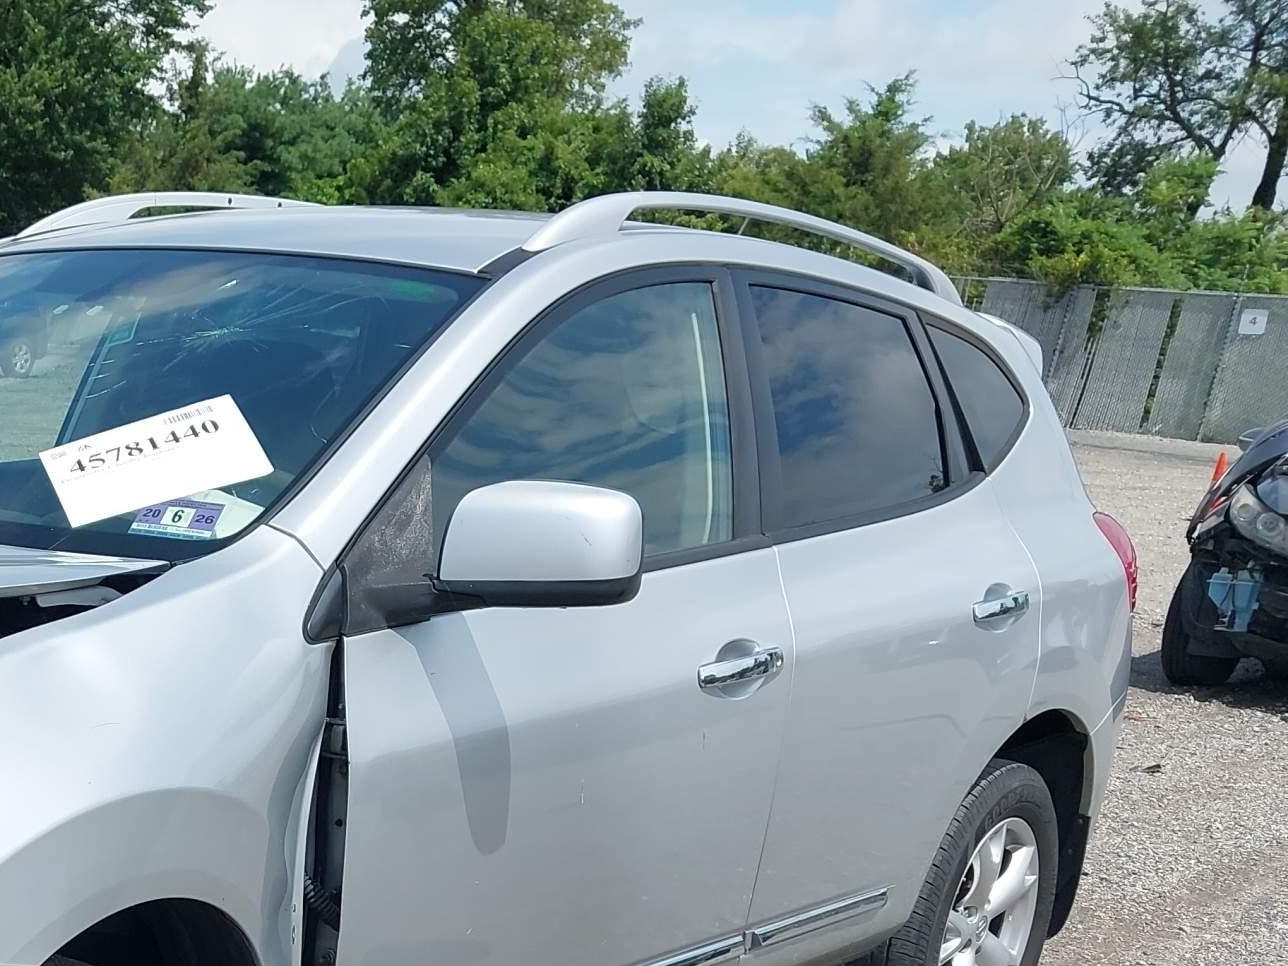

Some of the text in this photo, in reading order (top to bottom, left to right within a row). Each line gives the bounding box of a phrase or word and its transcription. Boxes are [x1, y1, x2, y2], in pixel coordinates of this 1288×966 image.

[1248, 316, 1257, 326] 4
[69, 418, 220, 473] 45781440
[142, 508, 215, 525] 20 6 26
